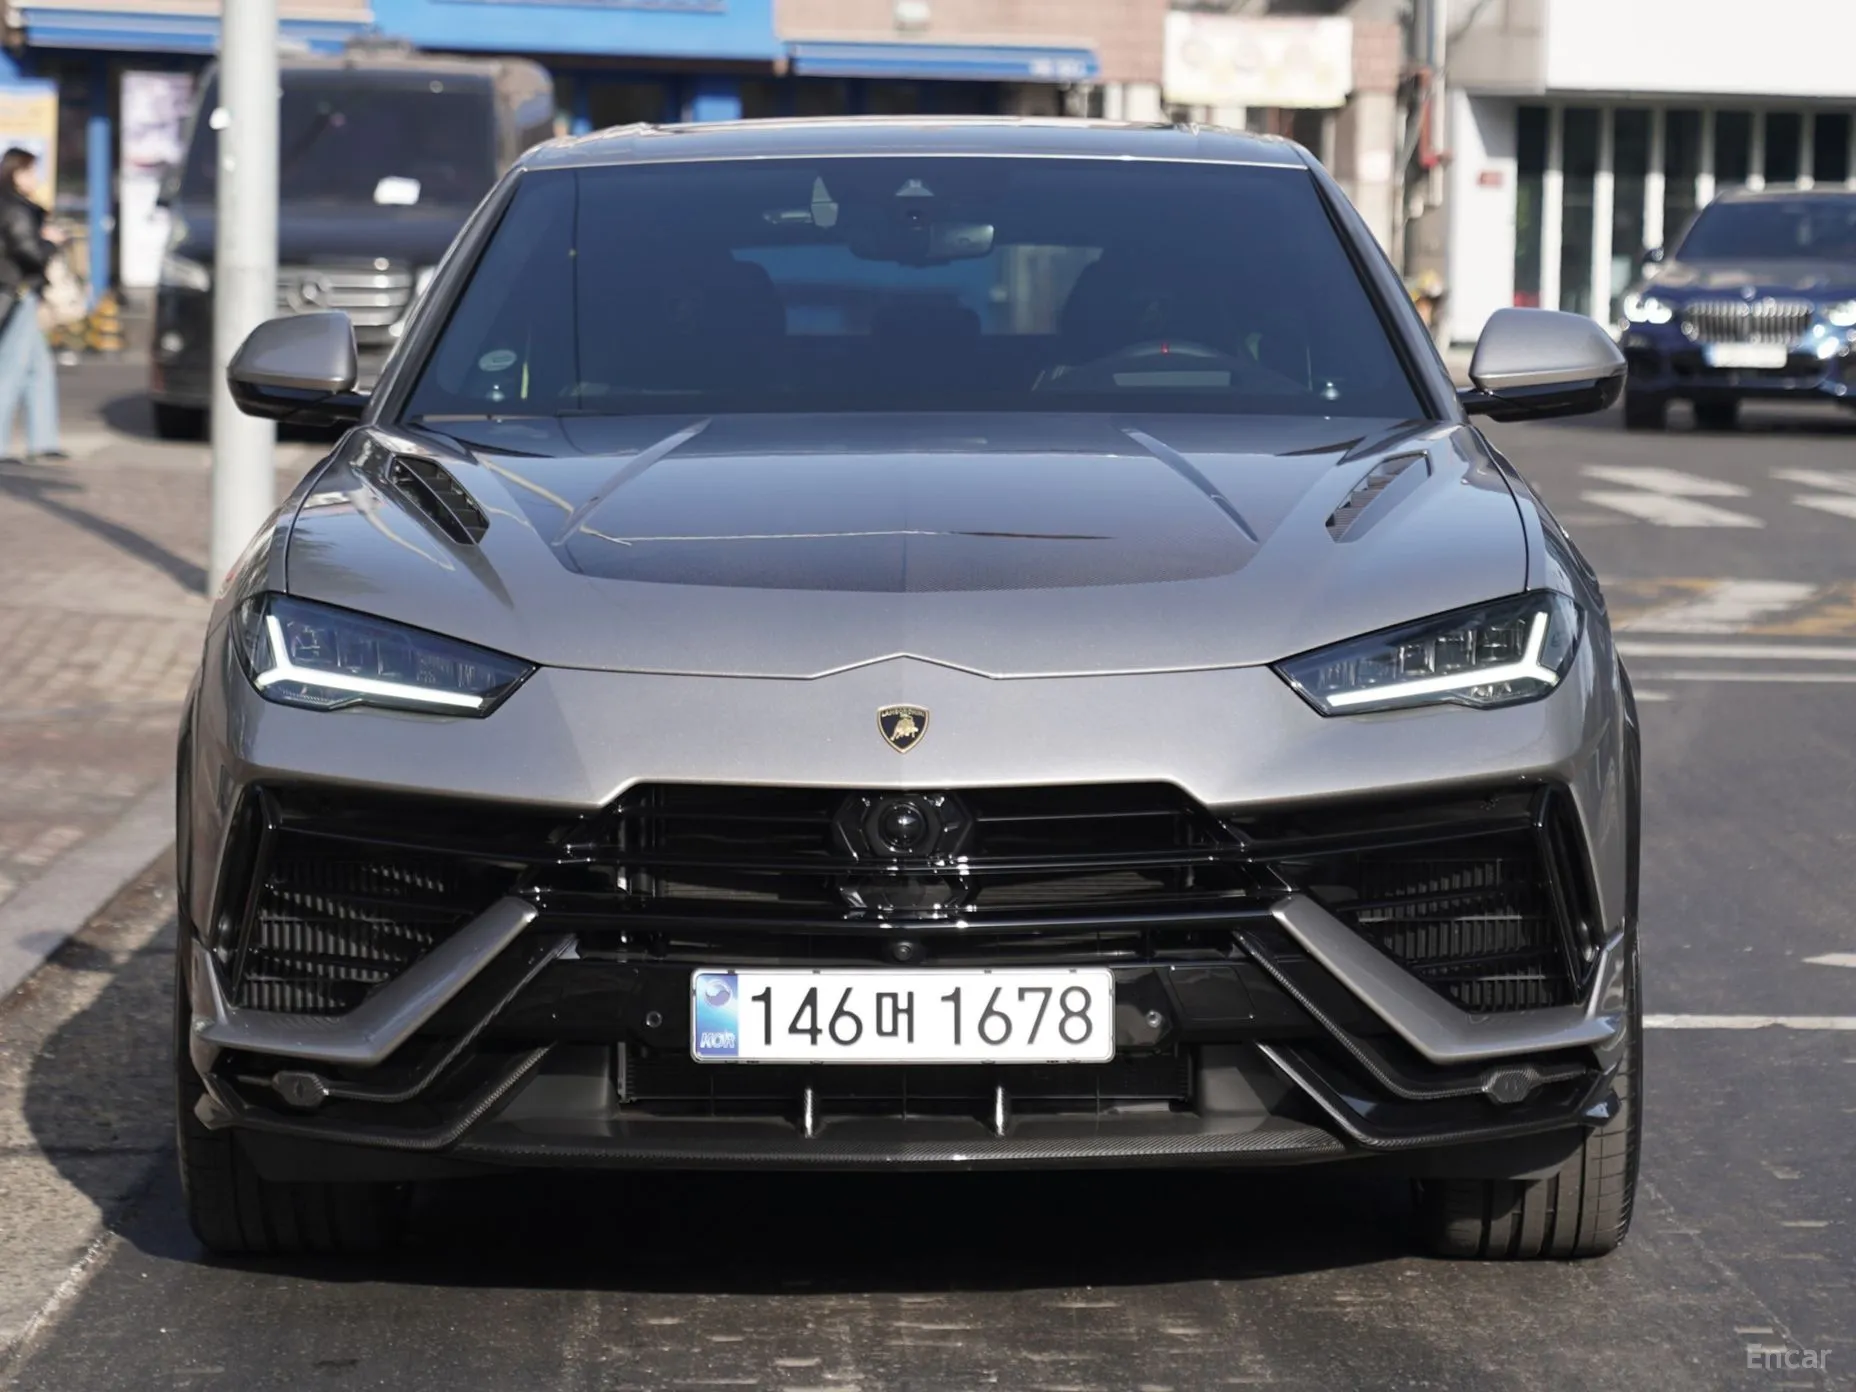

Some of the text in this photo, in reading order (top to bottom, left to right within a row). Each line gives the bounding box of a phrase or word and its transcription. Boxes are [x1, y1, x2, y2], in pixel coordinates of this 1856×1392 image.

[751, 986, 1093, 1046] 146머 1678
[700, 1031, 735, 1049] KOR
